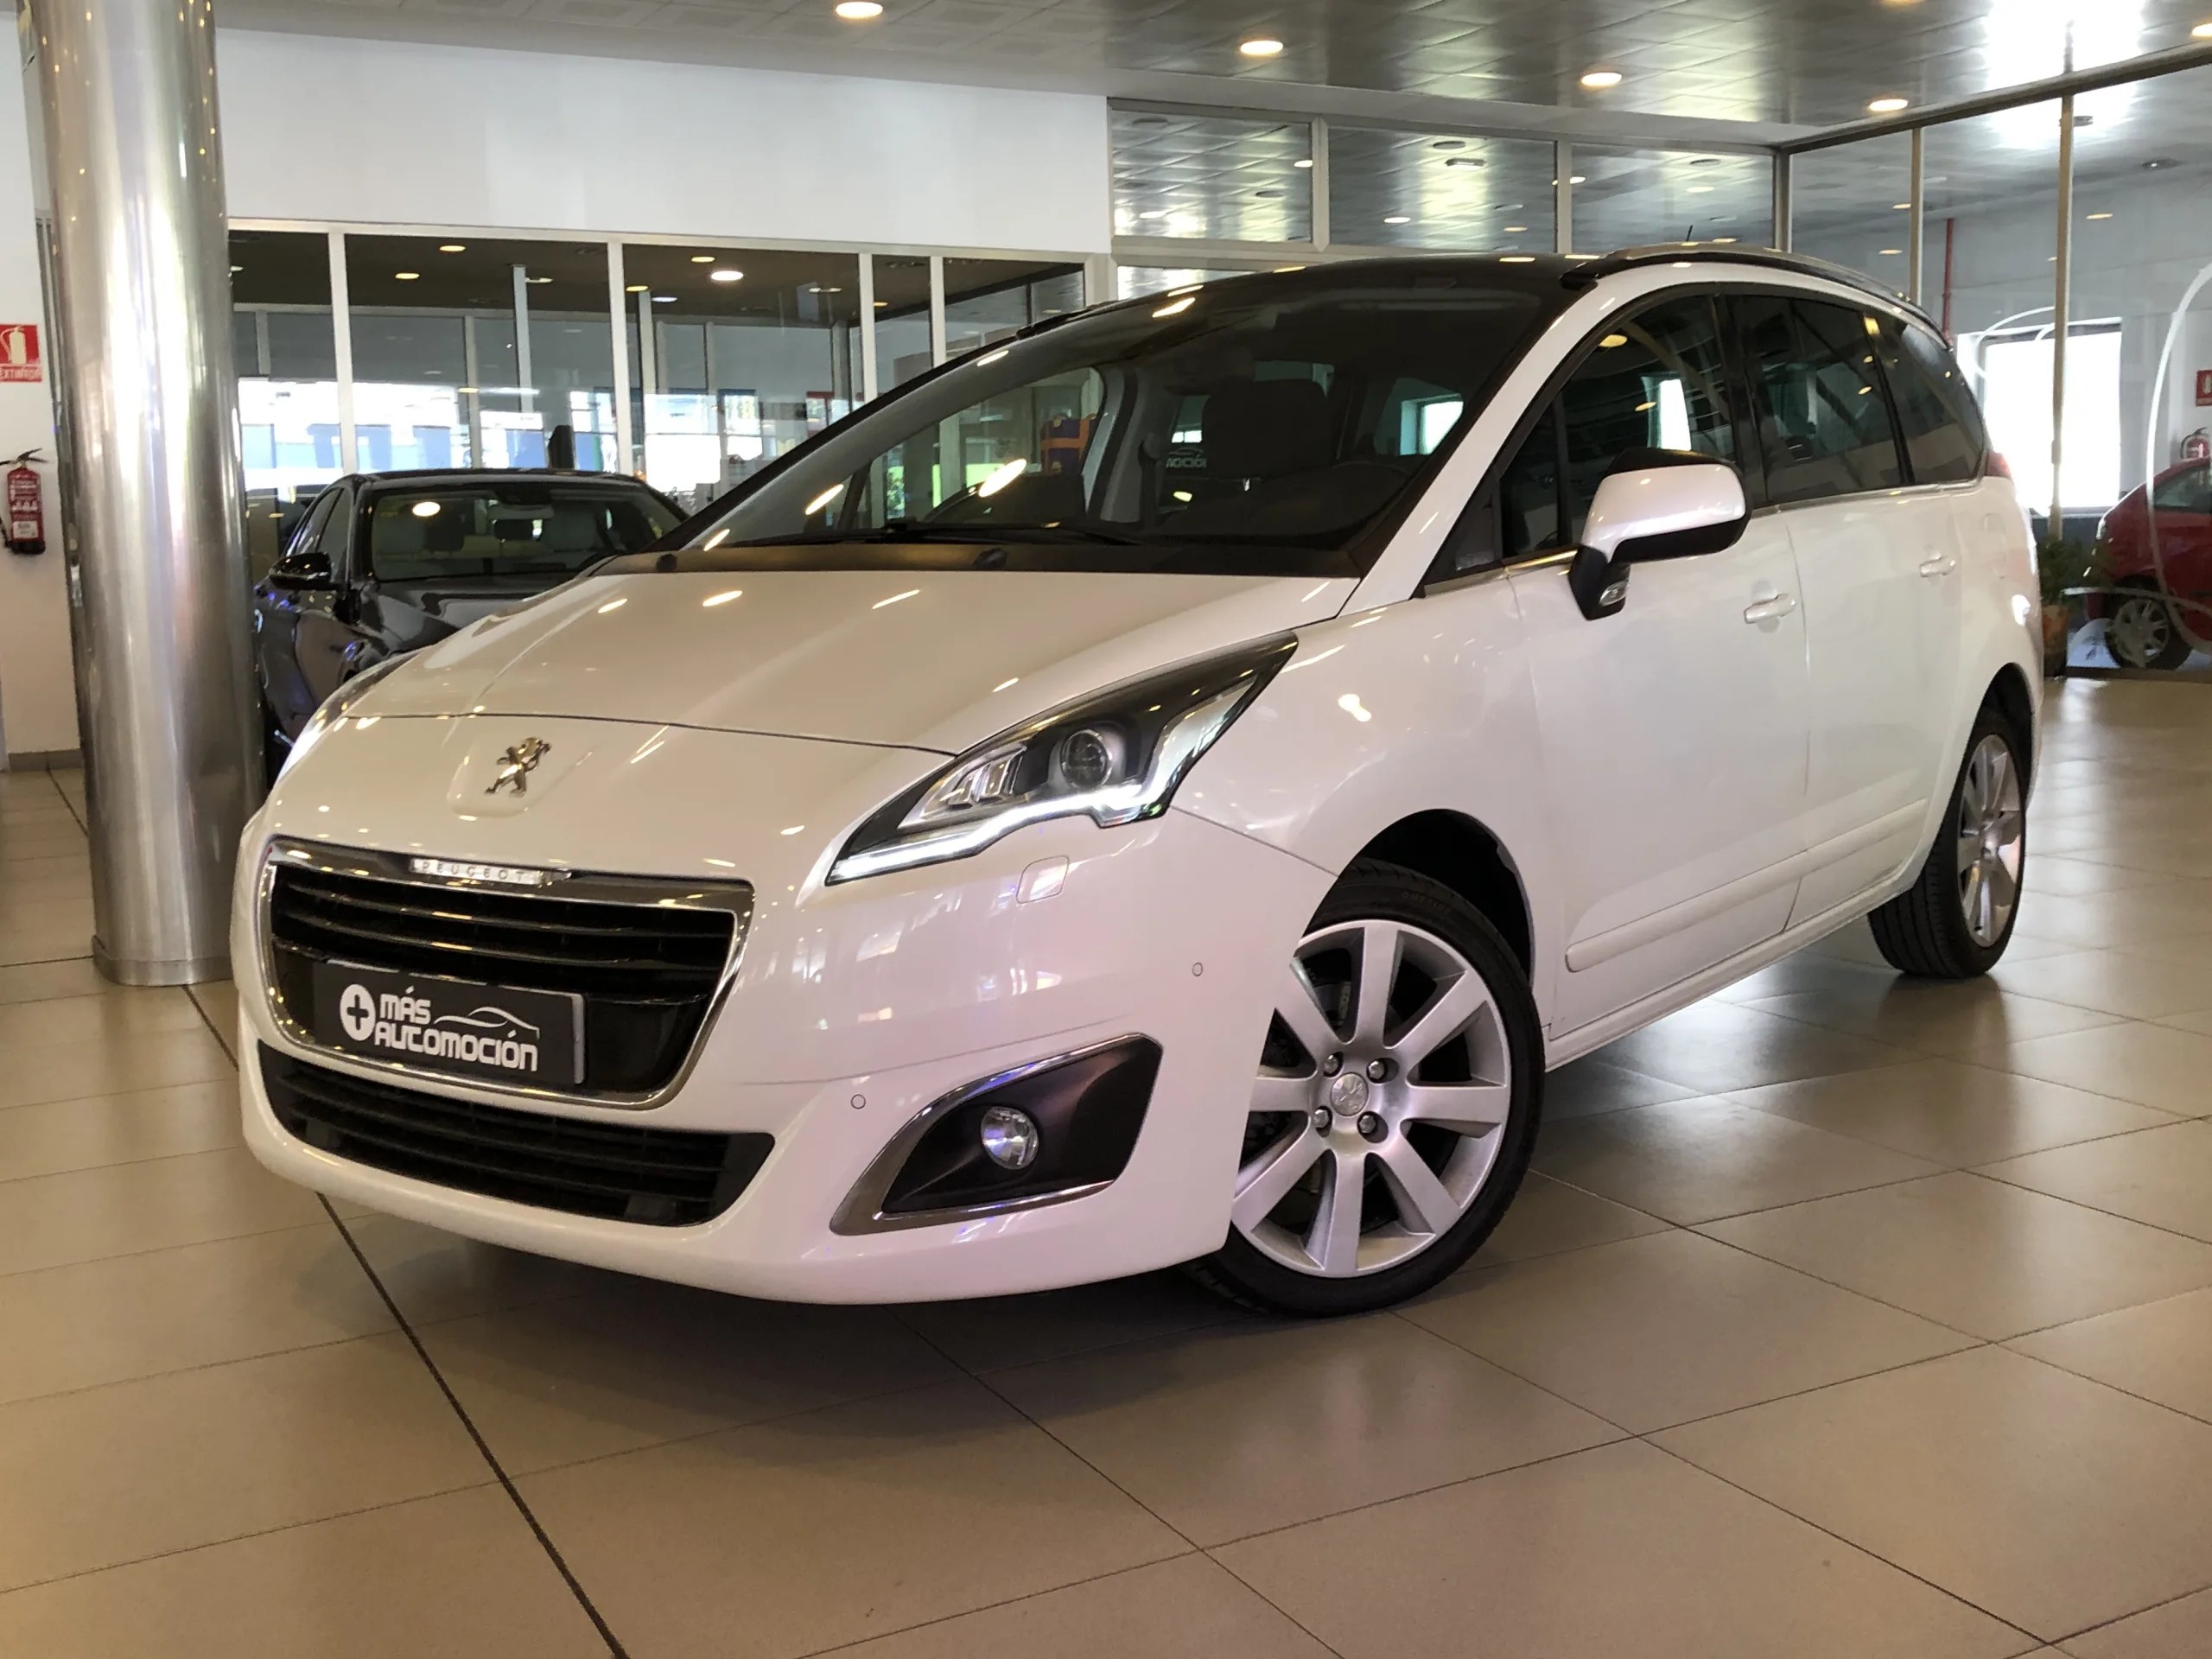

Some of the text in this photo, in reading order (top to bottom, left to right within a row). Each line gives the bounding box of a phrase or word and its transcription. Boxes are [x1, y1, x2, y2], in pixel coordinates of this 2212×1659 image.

[423, 861, 525, 882] PEUGEOT
[379, 985, 431, 1025] MÁS
[374, 1021, 537, 1071] AUTOMOCIÓN
